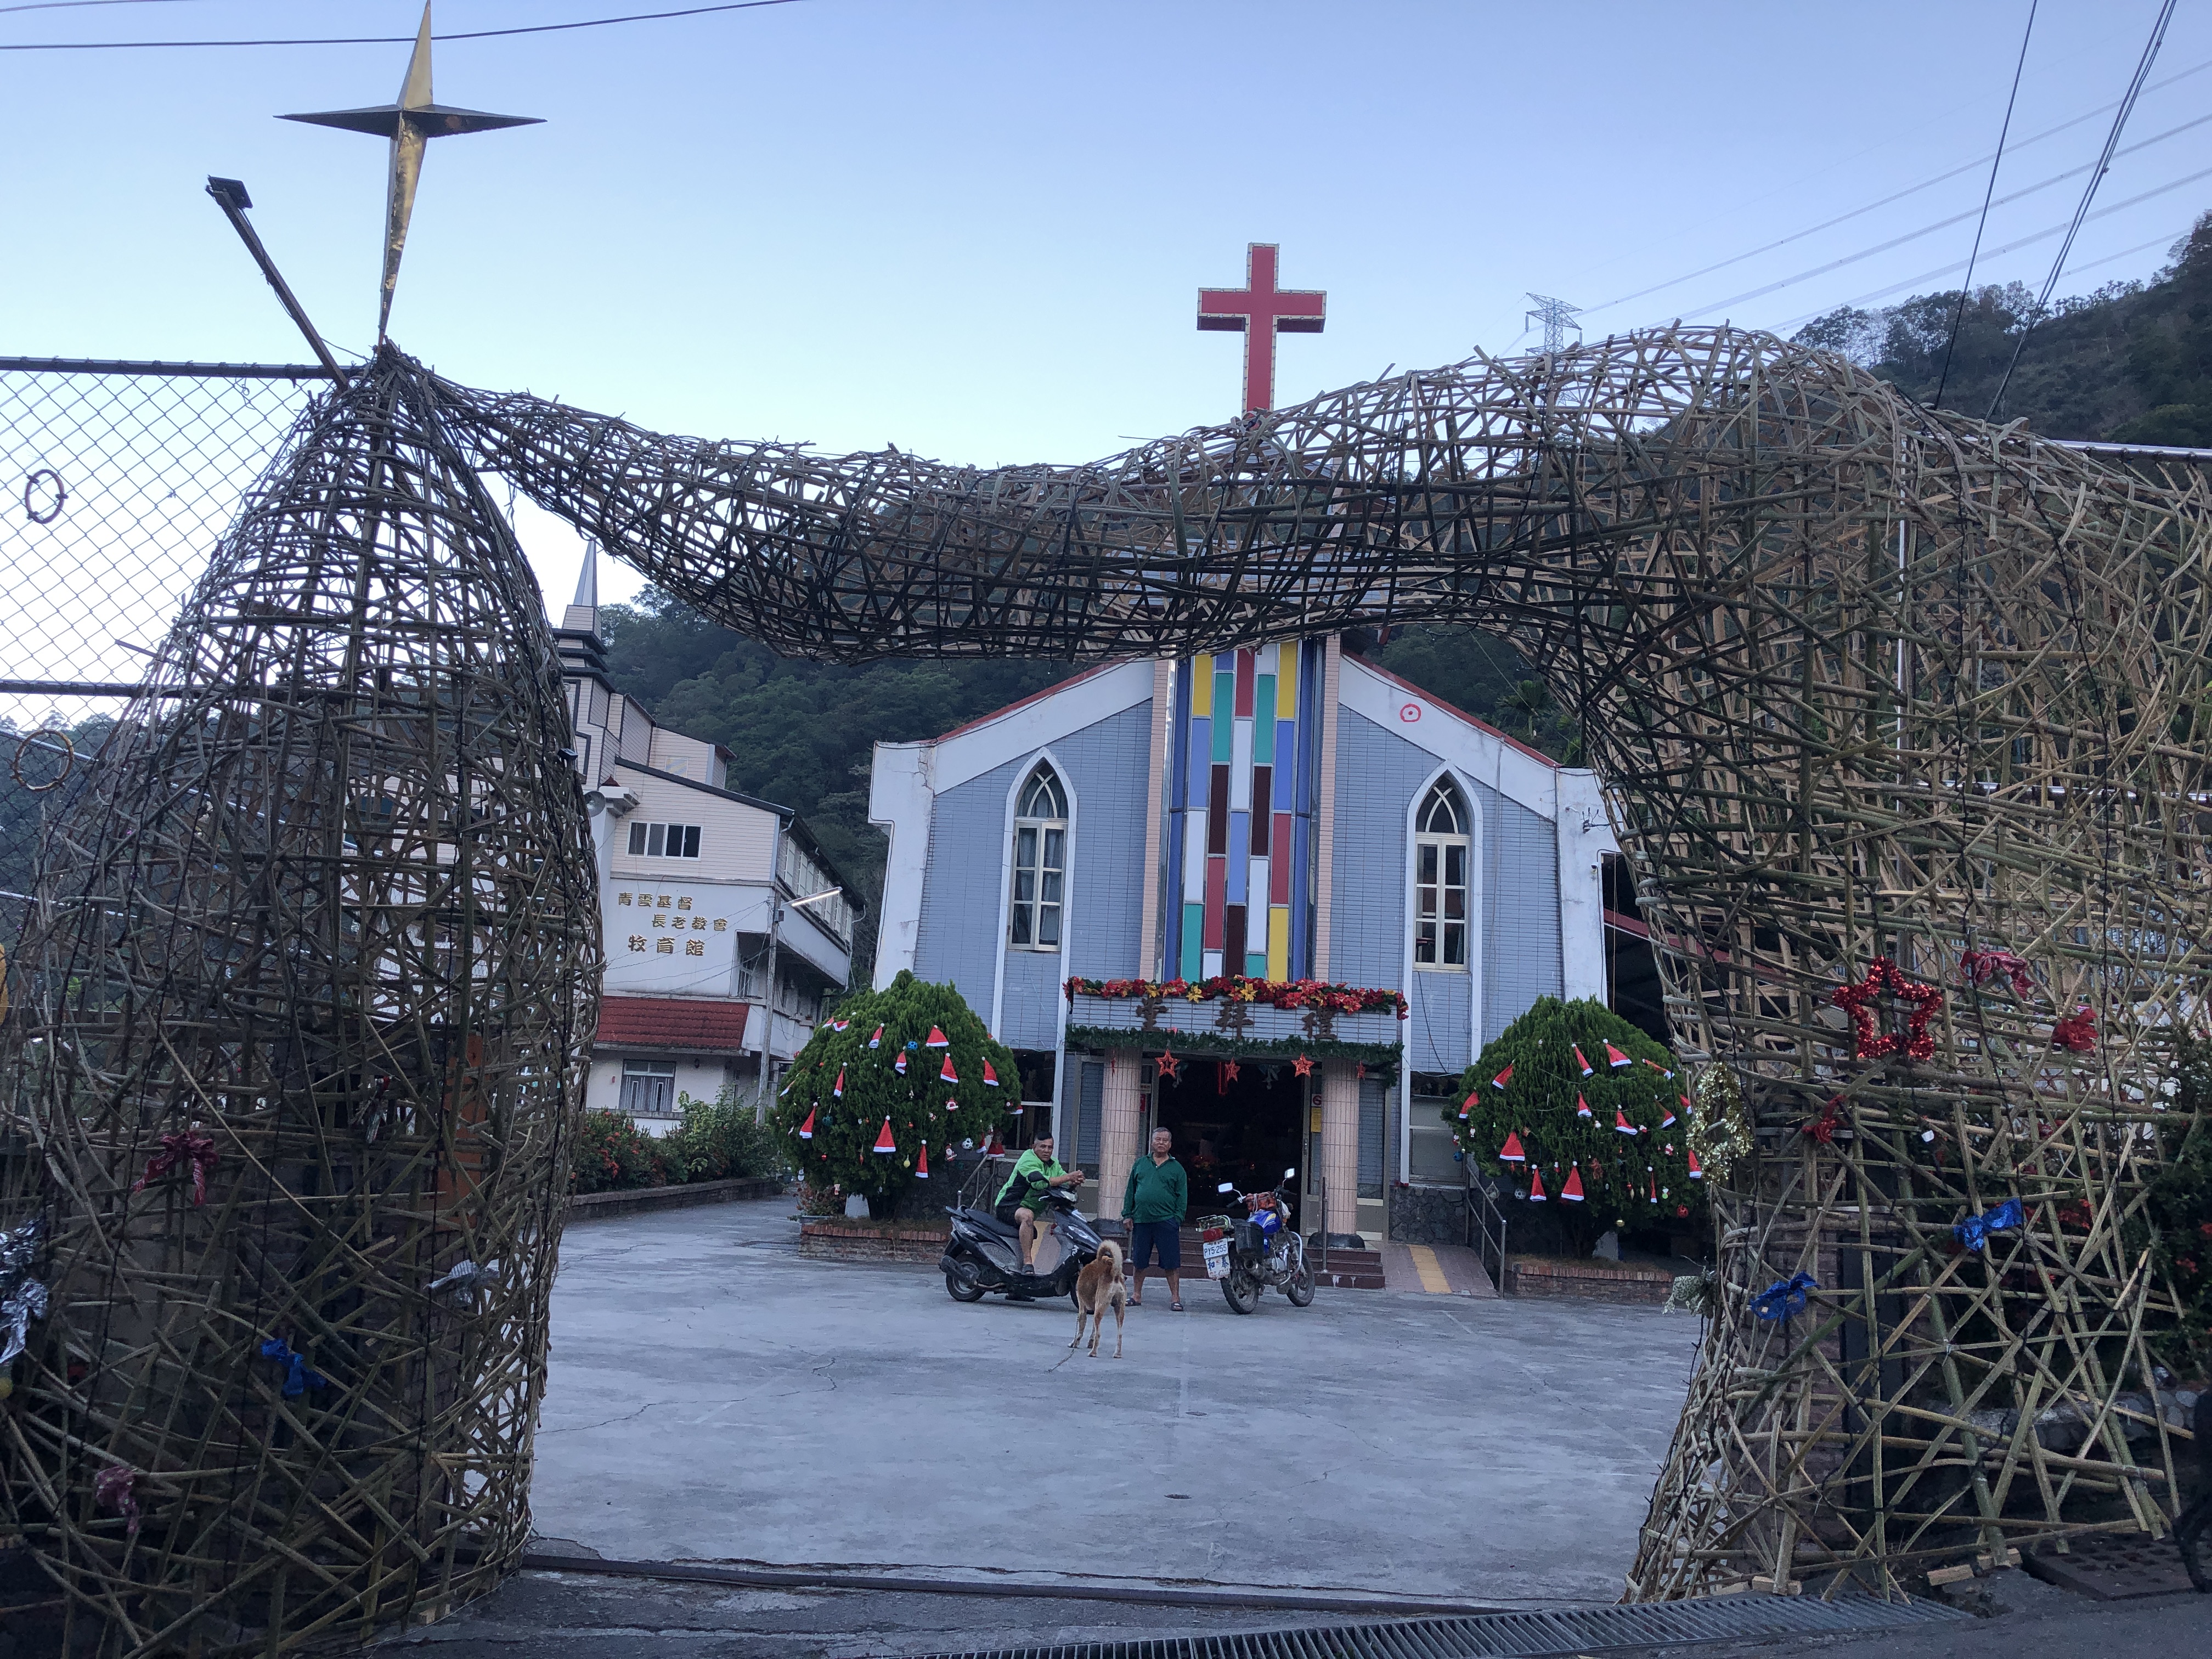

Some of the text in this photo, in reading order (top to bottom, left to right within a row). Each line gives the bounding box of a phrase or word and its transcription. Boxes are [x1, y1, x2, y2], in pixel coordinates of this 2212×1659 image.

[618, 892, 692, 911] 青雲基督
[652, 913, 728, 931] 長老教會
[628, 934, 705, 956] 牧育館
[1204, 1244, 1227, 1256] PY5-255
